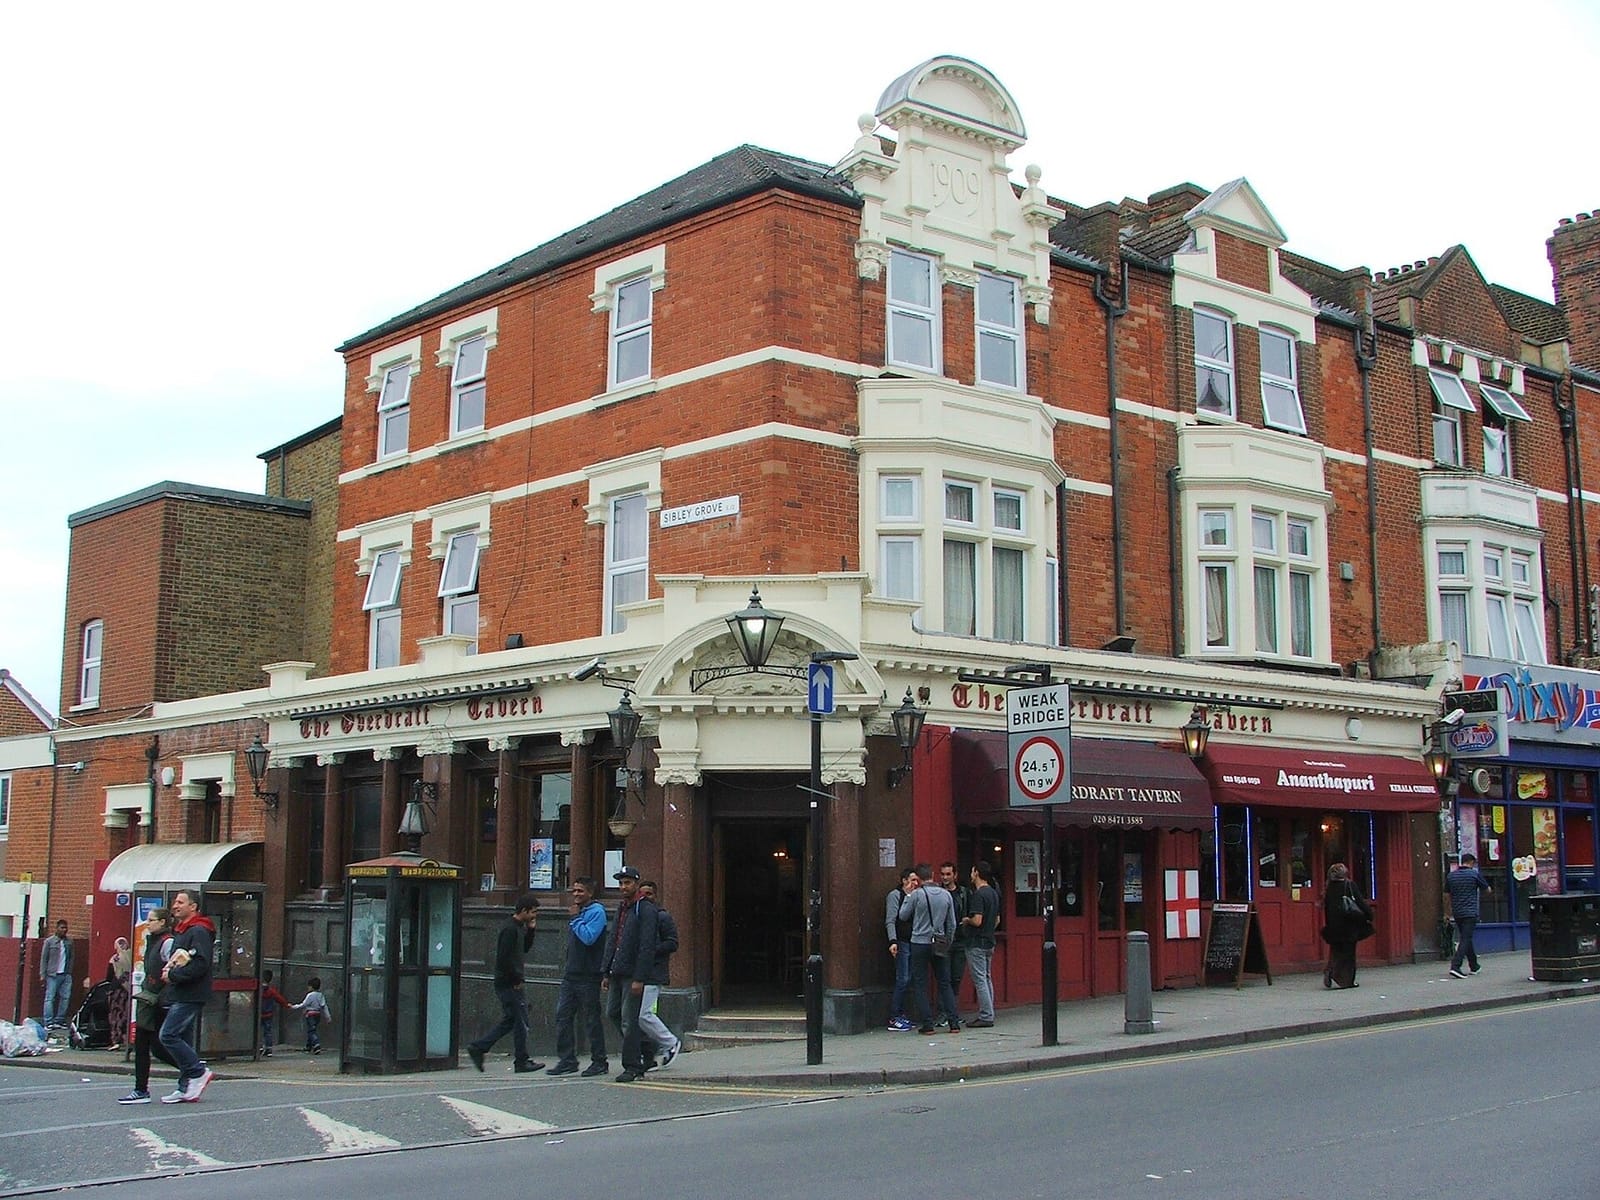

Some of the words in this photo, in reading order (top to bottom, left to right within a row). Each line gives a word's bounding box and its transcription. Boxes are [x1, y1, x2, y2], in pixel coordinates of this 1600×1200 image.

[929, 162, 980, 217] 1909
[663, 509, 692, 523] SIBLEY
[695, 502, 723, 516] GROVE
[951, 683, 1004, 711] The
[1018, 692, 1058, 708] WEAK
[300, 718, 329, 739] The
[341, 705, 430, 735] Overdraft
[466, 695, 543, 721] Tavern
[1013, 708, 1064, 725] BRIDGE
[1022, 760, 1048, 773] 24.5
[1277, 770, 1375, 793] Ananthapuri
[1072, 786, 1124, 800] RDRAFT
[1128, 788, 1182, 803] TAVERN
[1093, 815, 1106, 824] 020
[1108, 815, 1124, 825] 8471
[1127, 816, 1143, 825] 3585
[403, 868, 457, 877] TELEPHONE
